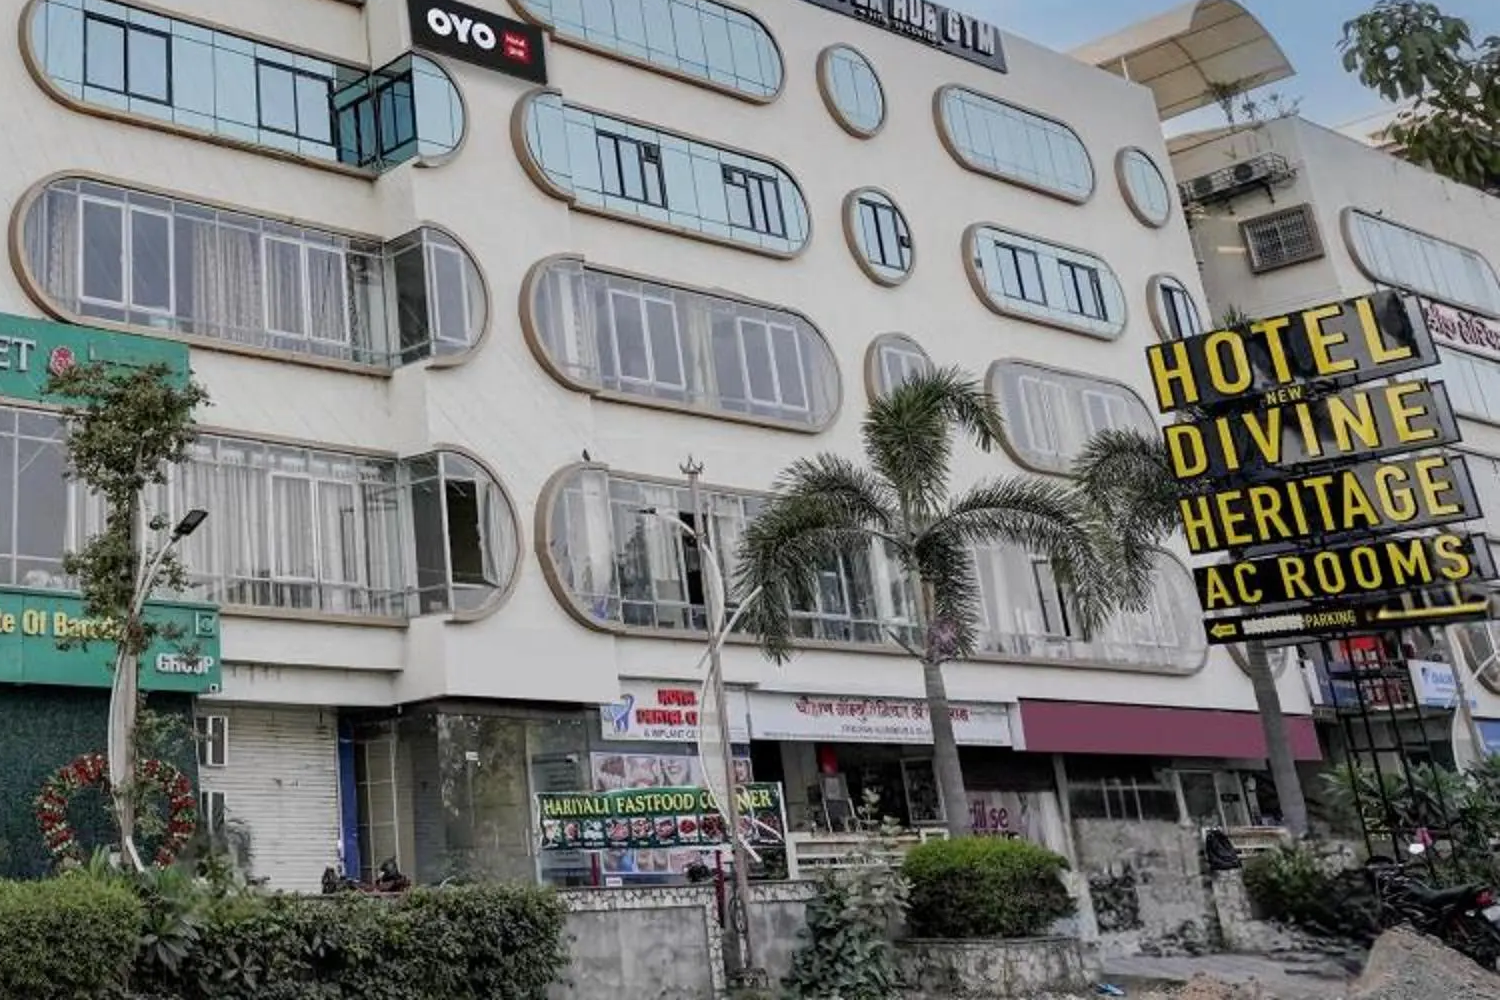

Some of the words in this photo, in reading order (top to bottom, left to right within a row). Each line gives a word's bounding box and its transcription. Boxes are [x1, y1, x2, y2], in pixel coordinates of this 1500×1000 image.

[427, 7, 497, 50] OYO
[947, 9, 997, 55] GYM
[1149, 297, 1413, 410] HOTEL
[1265, 386, 1304, 405] NEW
[1165, 381, 1437, 479] DIVINE
[1180, 455, 1460, 551] HERITAGE
[1206, 562, 1263, 609] AC
[1277, 534, 1470, 600] ROOMS
[1305, 610, 1357, 628] PARKING
[543, 795, 612, 817] HARIYALI
[617, 792, 695, 814] FASTFOOD
